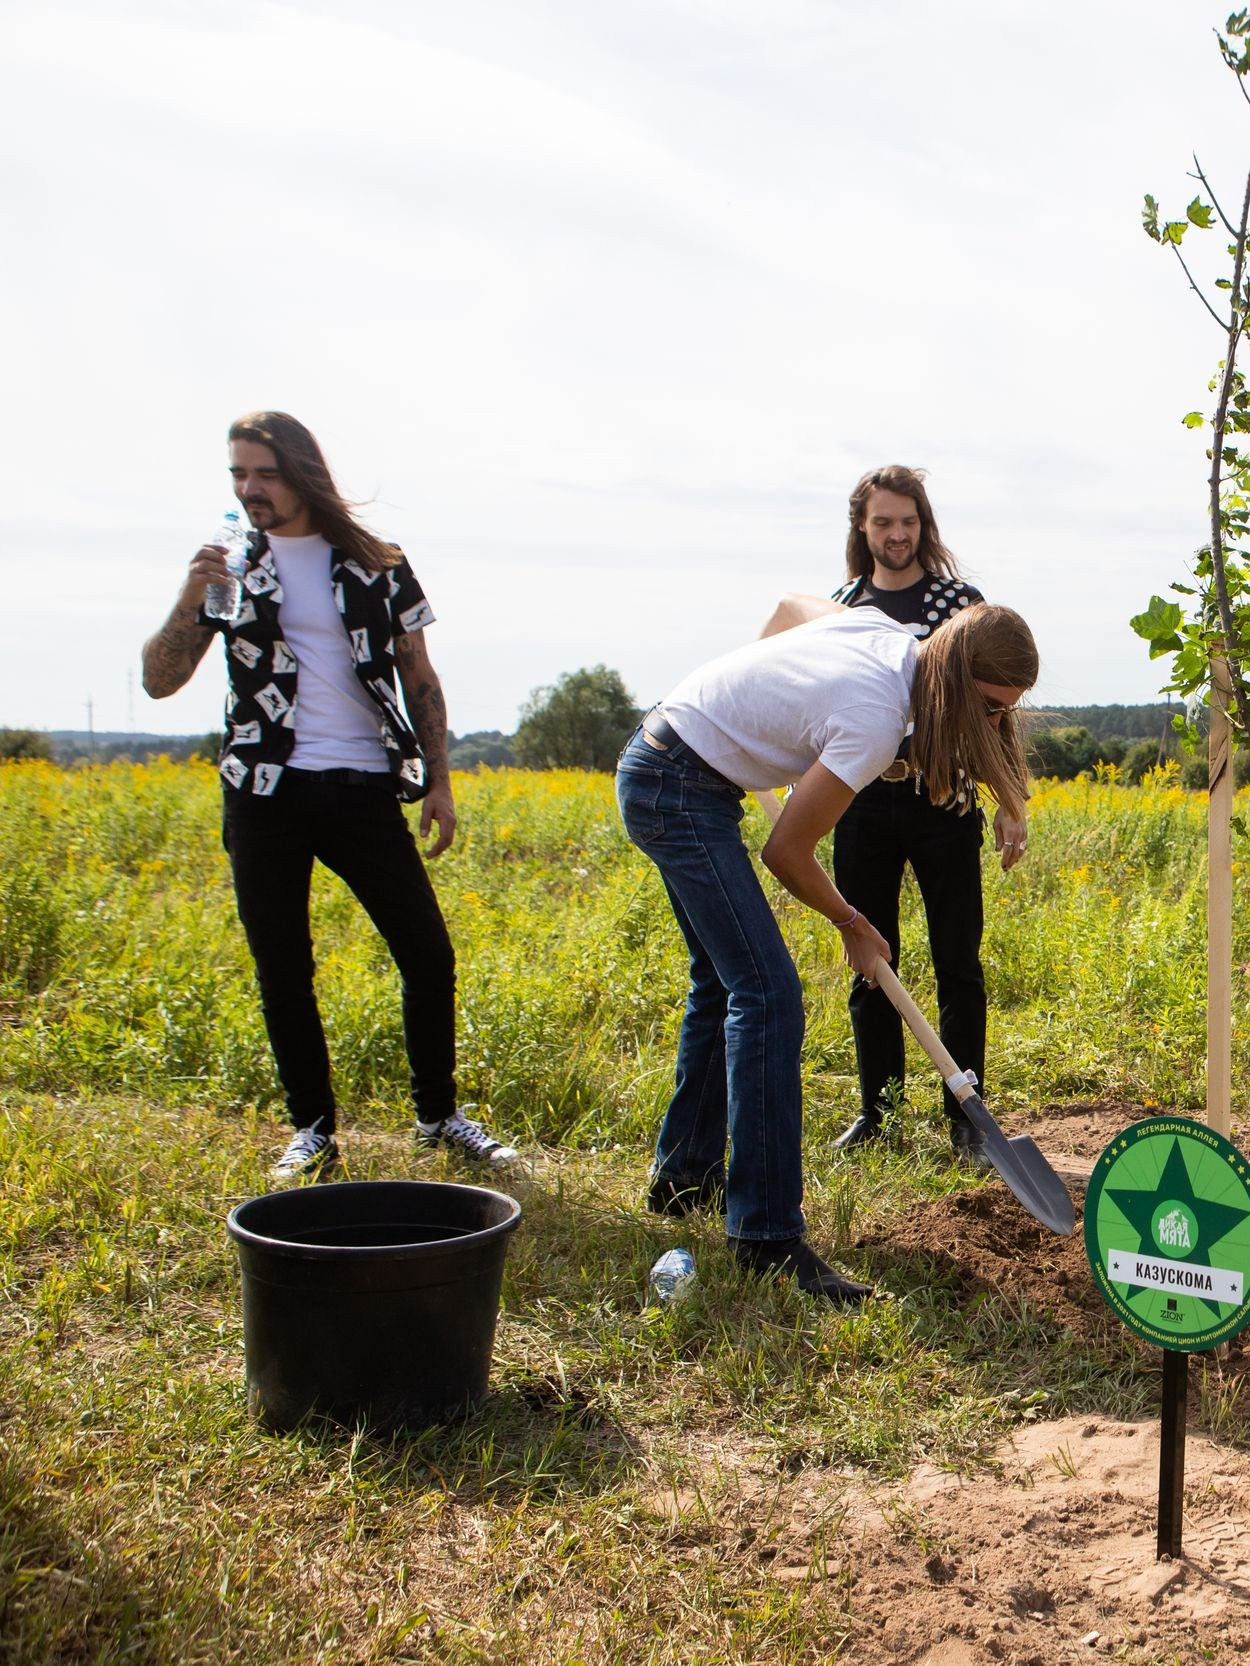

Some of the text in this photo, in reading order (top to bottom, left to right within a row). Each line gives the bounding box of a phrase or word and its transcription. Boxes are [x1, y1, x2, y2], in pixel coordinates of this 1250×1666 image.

[1136, 1123, 1219, 1148] ЛЕГЕНДАРНАЯ АЛЛЕЯ
[1158, 1218, 1189, 1235] ДИКАЯ
[1159, 1229, 1191, 1248] МЯТА
[1135, 1262, 1213, 1291] КАЗУСКОМА
[1116, 1301, 1129, 1317] 2021
[1127, 1314, 1142, 1328] ГОДУ
[1142, 1326, 1178, 1343] КОМПАНИЕЙ
[1160, 1310, 1184, 1322] ZION
